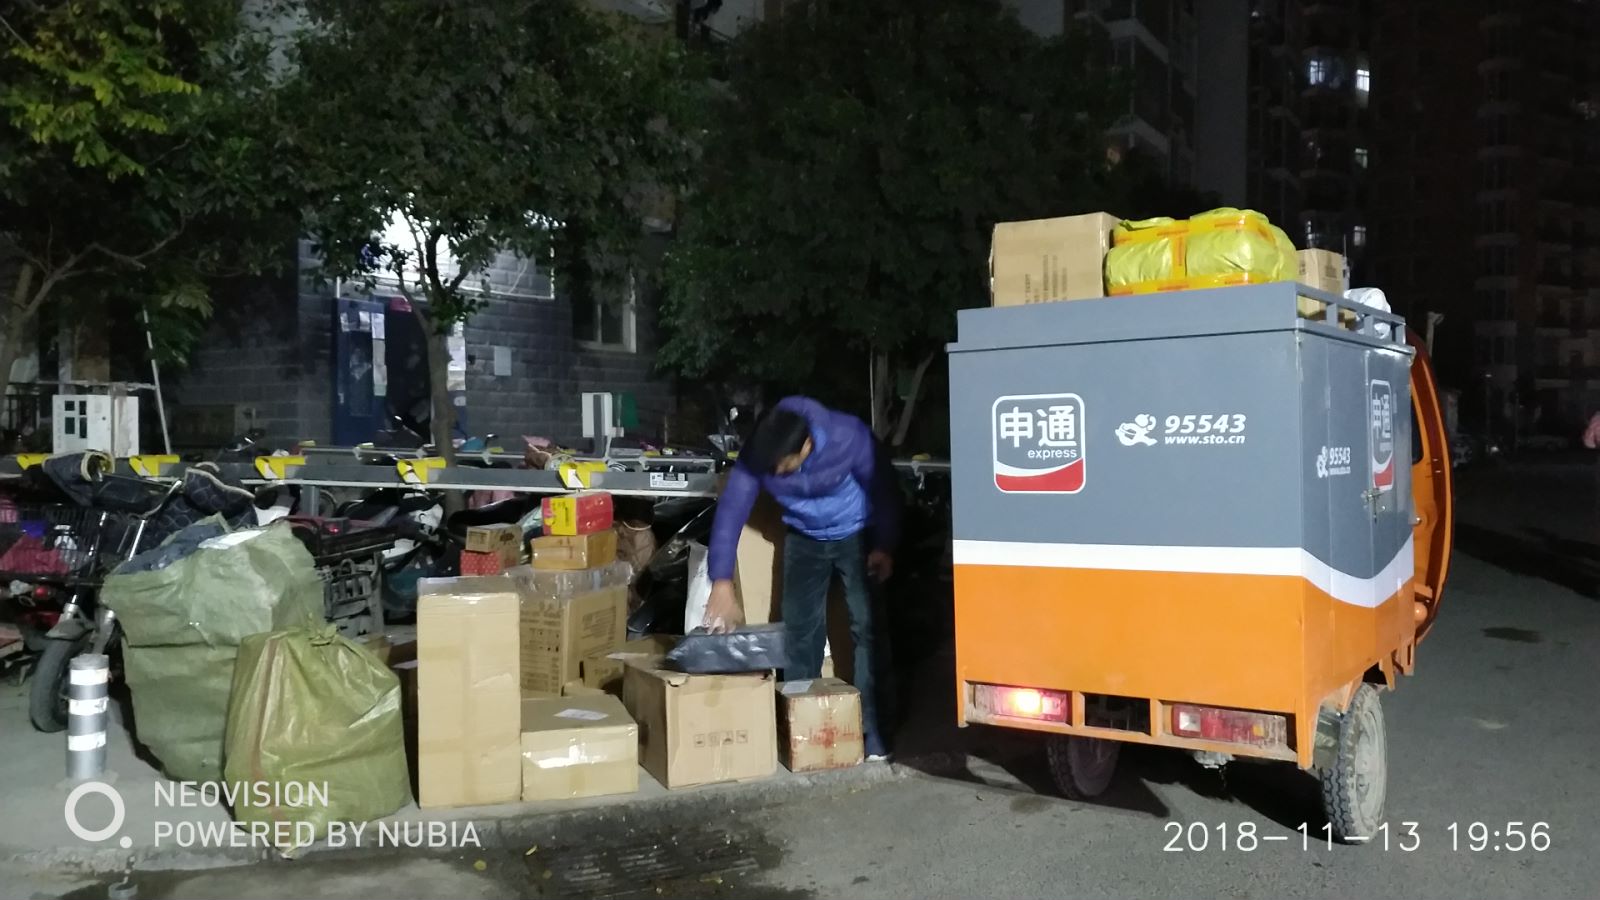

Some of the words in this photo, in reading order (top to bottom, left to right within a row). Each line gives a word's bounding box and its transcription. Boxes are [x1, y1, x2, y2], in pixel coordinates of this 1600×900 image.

[1000, 405, 1077, 448] 申通
[1165, 413, 1247, 433] 95543
[1165, 434, 1246, 445] www.sto.cn
[1027, 448, 1077, 460] express
[1329, 447, 1351, 465] 95543
